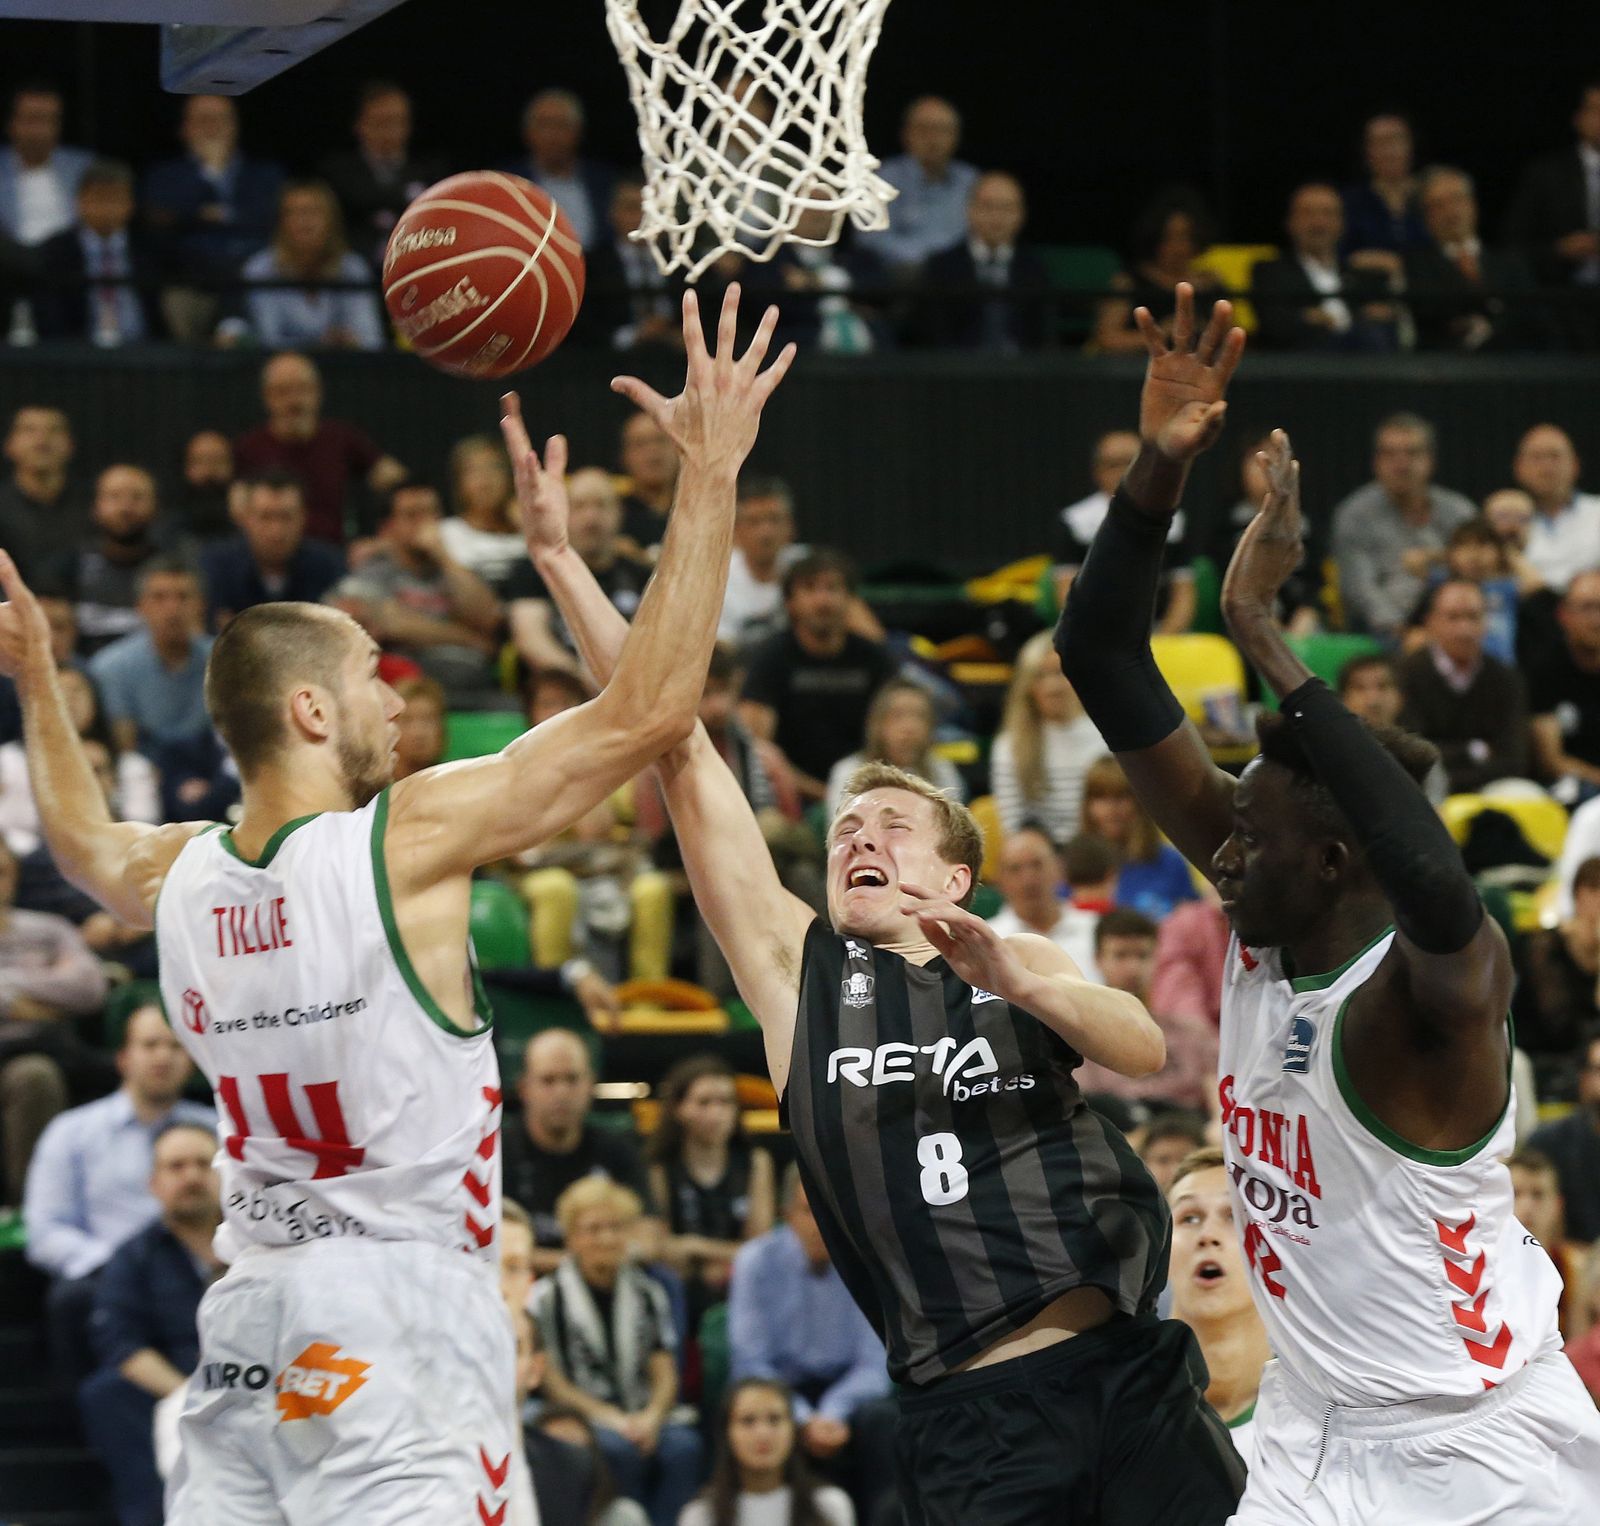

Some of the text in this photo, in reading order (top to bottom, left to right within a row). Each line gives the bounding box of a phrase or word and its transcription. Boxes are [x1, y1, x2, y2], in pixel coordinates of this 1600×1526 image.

[212, 896, 293, 957] TILLIE
[252, 1010, 280, 1029] the
[284, 997, 368, 1027] Children
[827, 1036, 999, 1097] RETA
[218, 1072, 366, 1180] 14
[916, 1132, 970, 1206] 8
